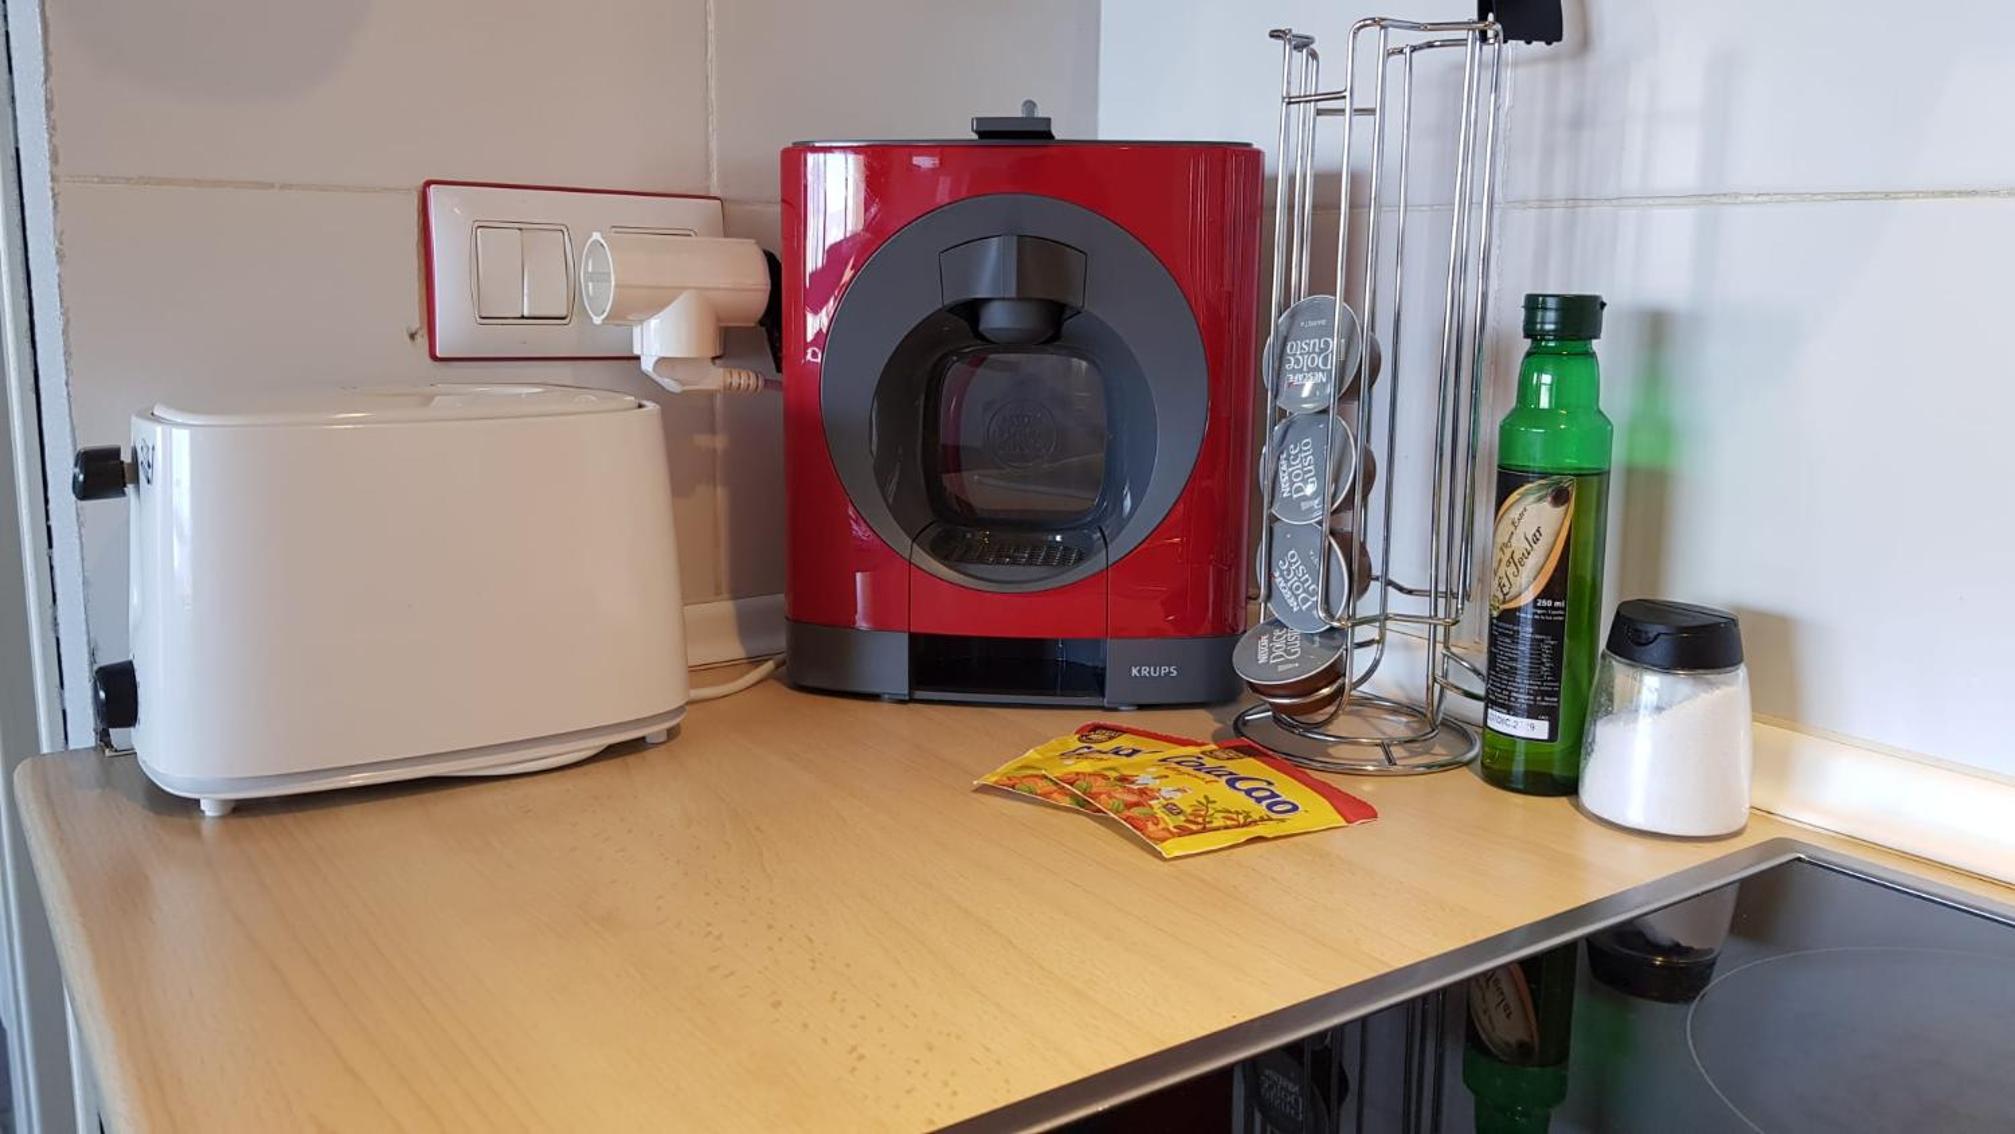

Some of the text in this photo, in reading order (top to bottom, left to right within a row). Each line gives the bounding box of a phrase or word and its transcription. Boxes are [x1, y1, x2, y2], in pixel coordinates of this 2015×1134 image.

[1286, 337, 1332, 355] Gusto
[1285, 352, 1332, 371] Dolce
[1287, 441, 1306, 499] Dolce
[1278, 555, 1313, 612] Dolce
[1537, 598, 1565, 608] 250 ml
[1269, 628, 1287, 663] Dolce
[1131, 665, 1178, 677] KRUPS
